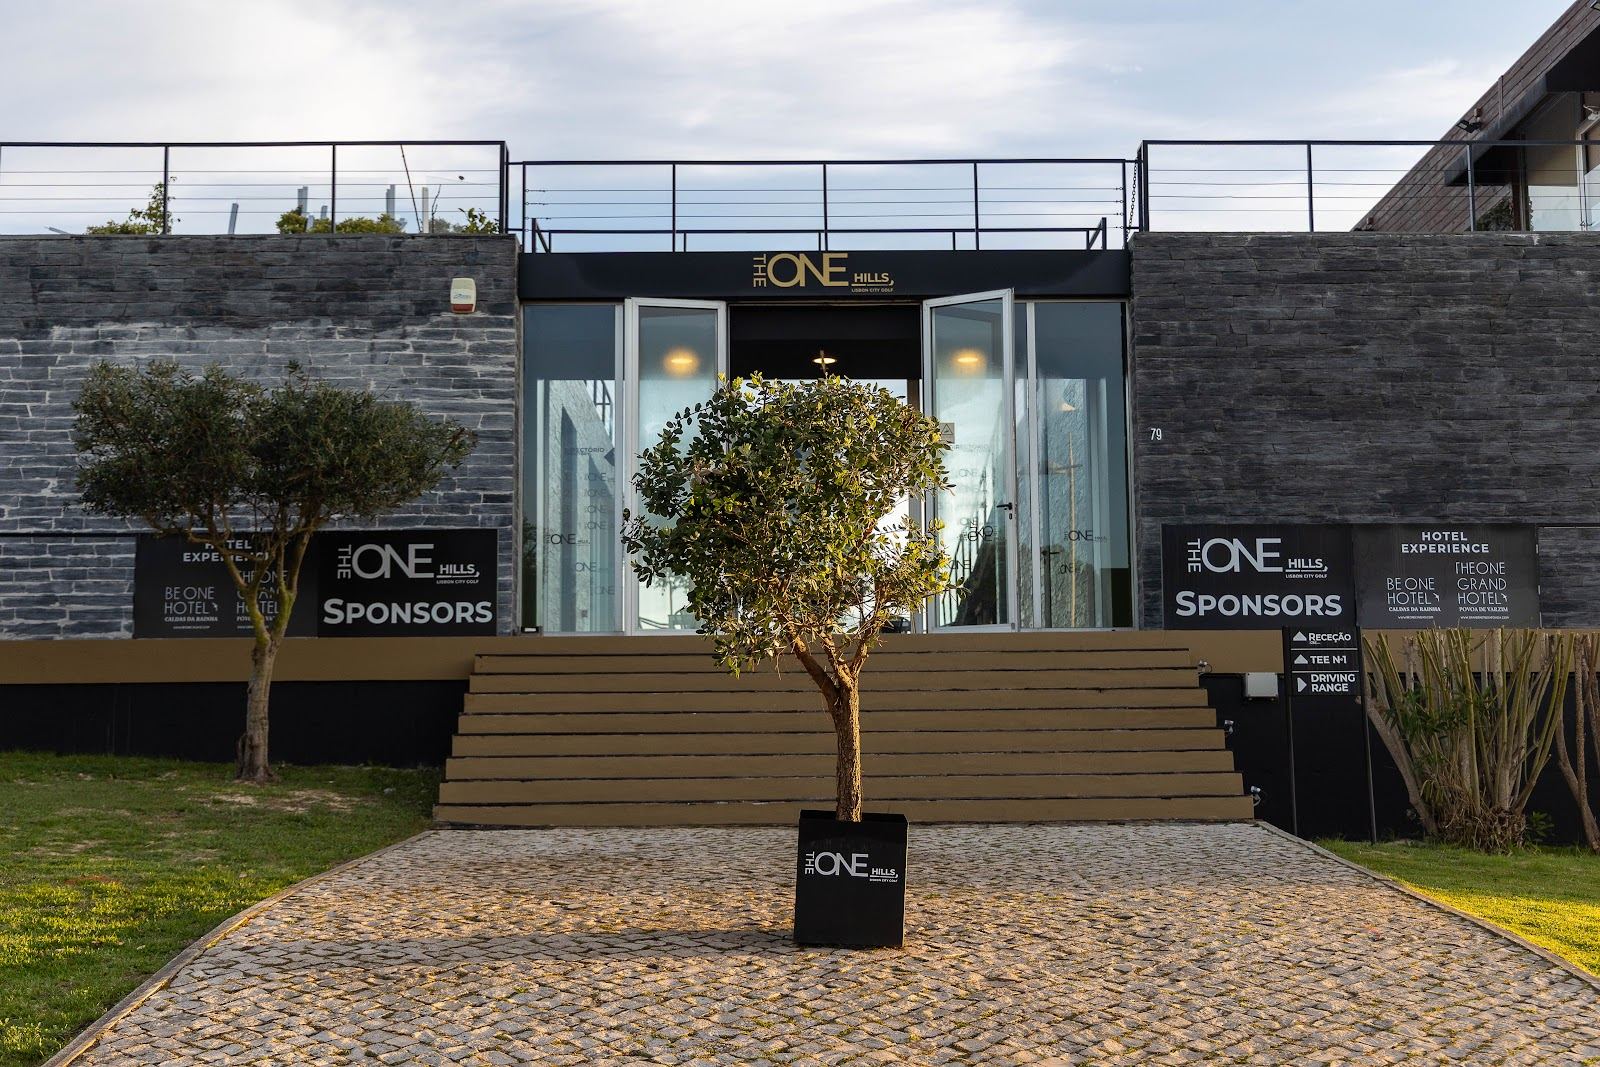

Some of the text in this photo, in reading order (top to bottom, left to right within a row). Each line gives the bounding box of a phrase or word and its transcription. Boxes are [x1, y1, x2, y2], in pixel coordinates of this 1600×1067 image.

[753, 252, 890, 288] THE ONE HILLS
[1150, 427, 1162, 441] 79
[550, 533, 576, 545] ONE
[1068, 529, 1093, 541] ONE
[1421, 531, 1468, 541] HOTEL
[203, 540, 252, 549] HTEL
[1401, 543, 1490, 553] EXPERIENCE
[337, 543, 475, 579] THE ONE HILLS
[1187, 537, 1323, 573] THE ONE HILLS
[1386, 577, 1436, 591] BE ONE
[1457, 577, 1507, 591] GRAND
[165, 586, 215, 600] BE ONE
[1387, 591, 1432, 605] HOTEL
[1457, 591, 1502, 605] HOTEL
[164, 601, 210, 614] HOTEL
[236, 601, 280, 614] HTEL
[1310, 655, 1330, 664] TEE
[1310, 673, 1356, 682] DRIVING
[1311, 683, 1349, 692] RANGE
[804, 851, 896, 877] THE ONE HILLS
